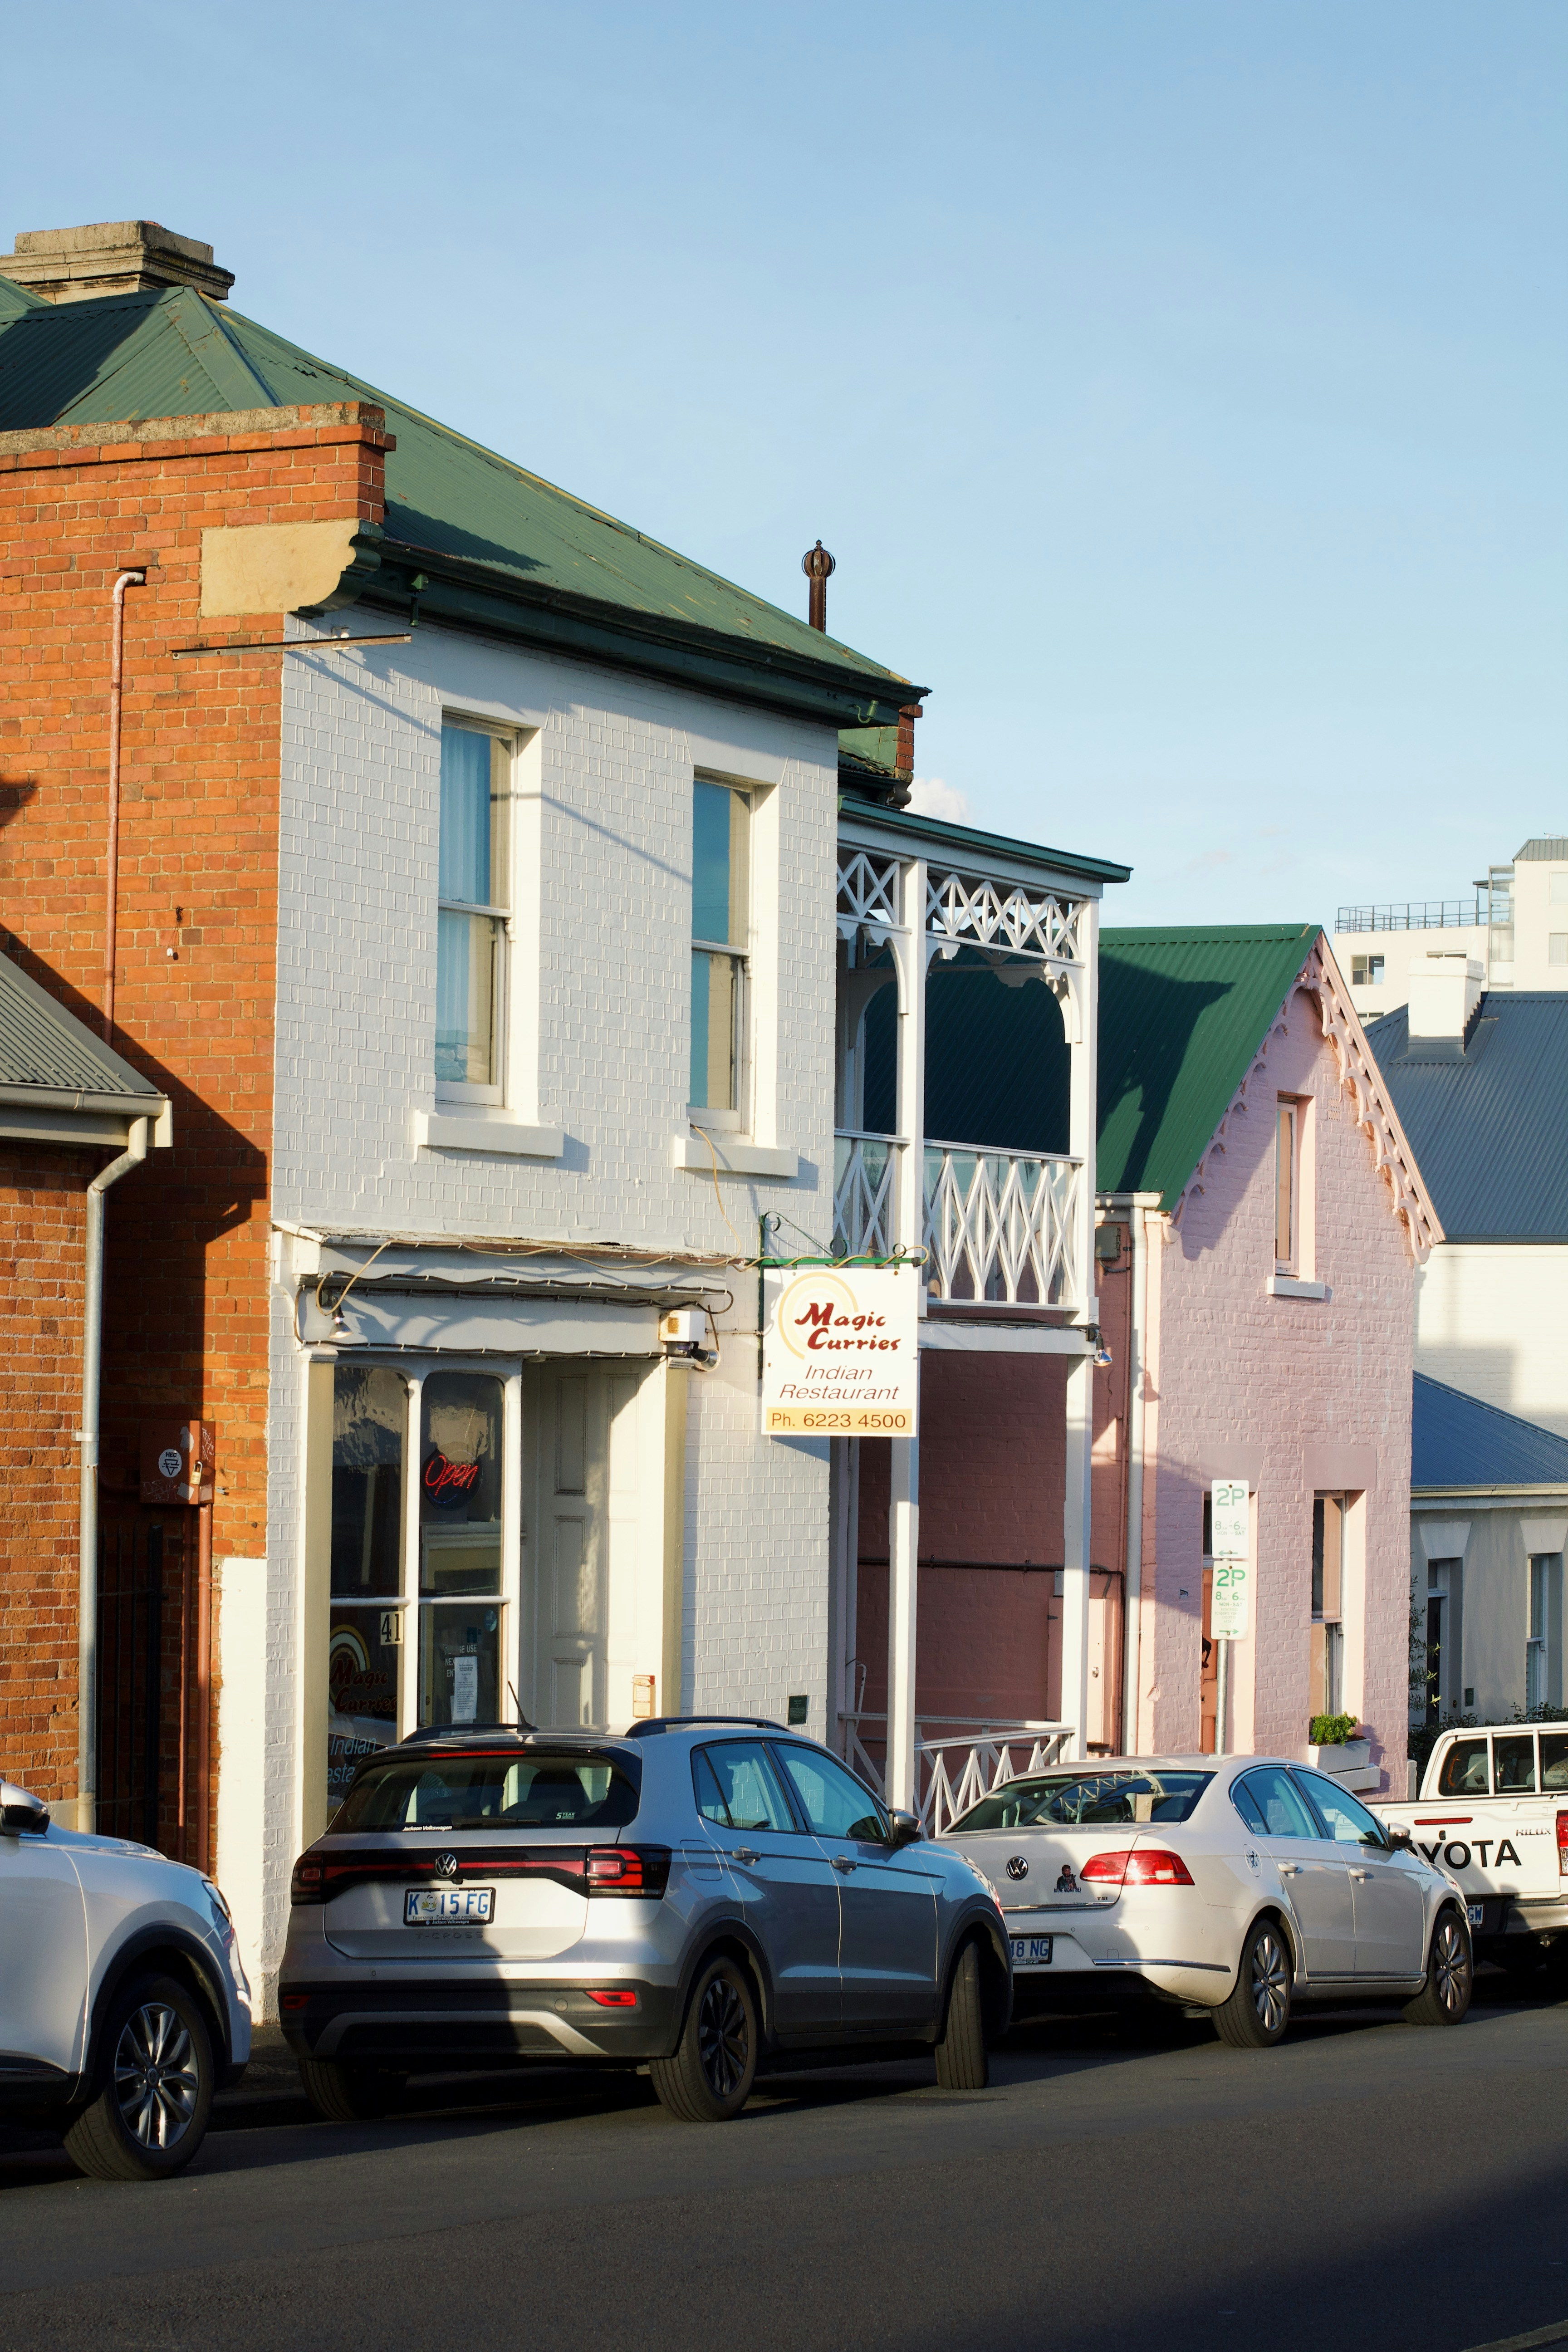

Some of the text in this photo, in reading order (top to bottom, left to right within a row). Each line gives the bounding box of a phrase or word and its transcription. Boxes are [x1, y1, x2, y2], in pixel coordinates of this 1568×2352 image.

[794, 1303, 886, 1331] Magic
[807, 1328, 901, 1351] Curries
[805, 1365, 872, 1380] Indian
[779, 1384, 899, 1400] Restaurant
[772, 1413, 906, 1428] Ph. 6223 4500
[425, 1455, 478, 1496] Open
[1216, 1488, 1245, 1506] 2P
[1216, 1569, 1245, 1587] 2P
[381, 1613, 400, 1642] 41
[467, 1644, 477, 1652] USE
[445, 1658, 455, 1666] NEX
[330, 1658, 388, 1690] Magic
[334, 1686, 397, 1713] Curries
[330, 1734, 377, 1755] Indian
[1516, 1828, 1552, 1836] HILUX
[1411, 1839, 1522, 1870] YOTA
[408, 1893, 489, 1915] K 15 FG
[1467, 1906, 1482, 1921] GW
[1030, 1940, 1049, 1957] NG
